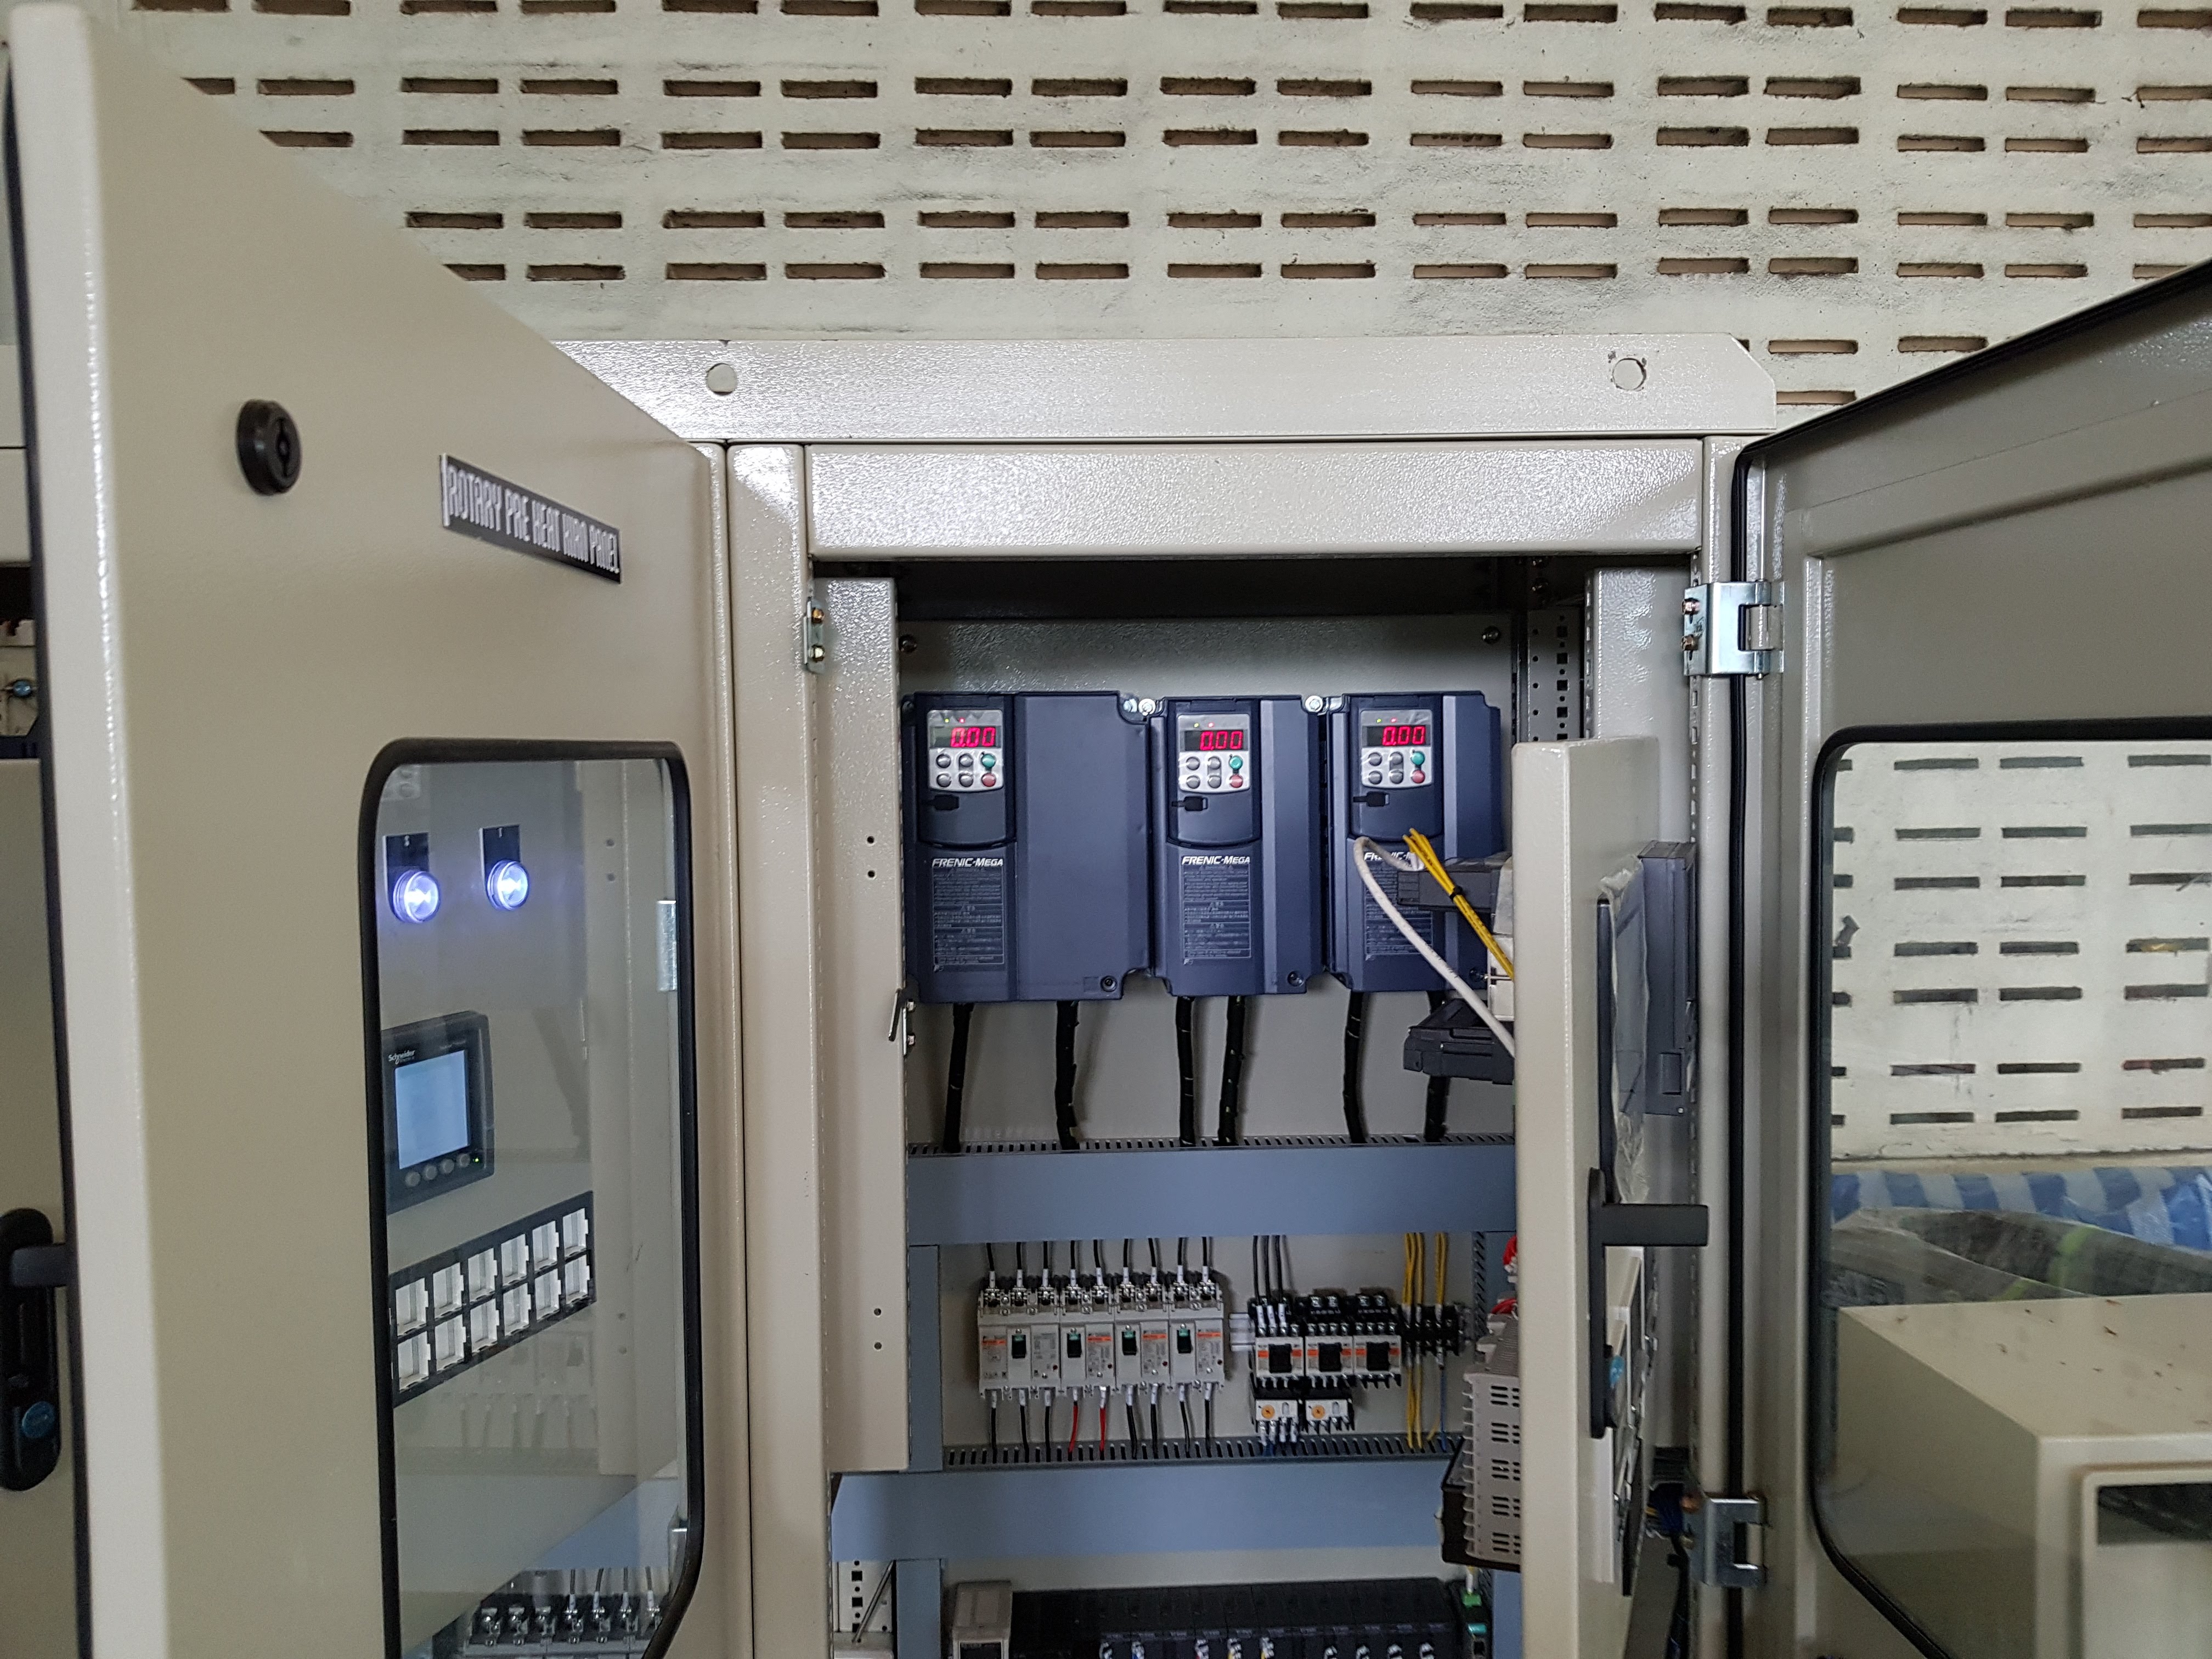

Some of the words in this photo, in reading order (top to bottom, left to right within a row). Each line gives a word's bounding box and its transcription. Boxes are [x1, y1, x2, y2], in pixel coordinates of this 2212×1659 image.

[447, 465, 501, 532] ROTARY
[504, 488, 531, 541] PRE
[589, 524, 619, 574] PANEL
[950, 726, 996, 748] 0.00
[1199, 730, 1244, 751] 0.00
[1381, 725, 1426, 747] 0.00
[388, 1050, 415, 1065] Schneider
